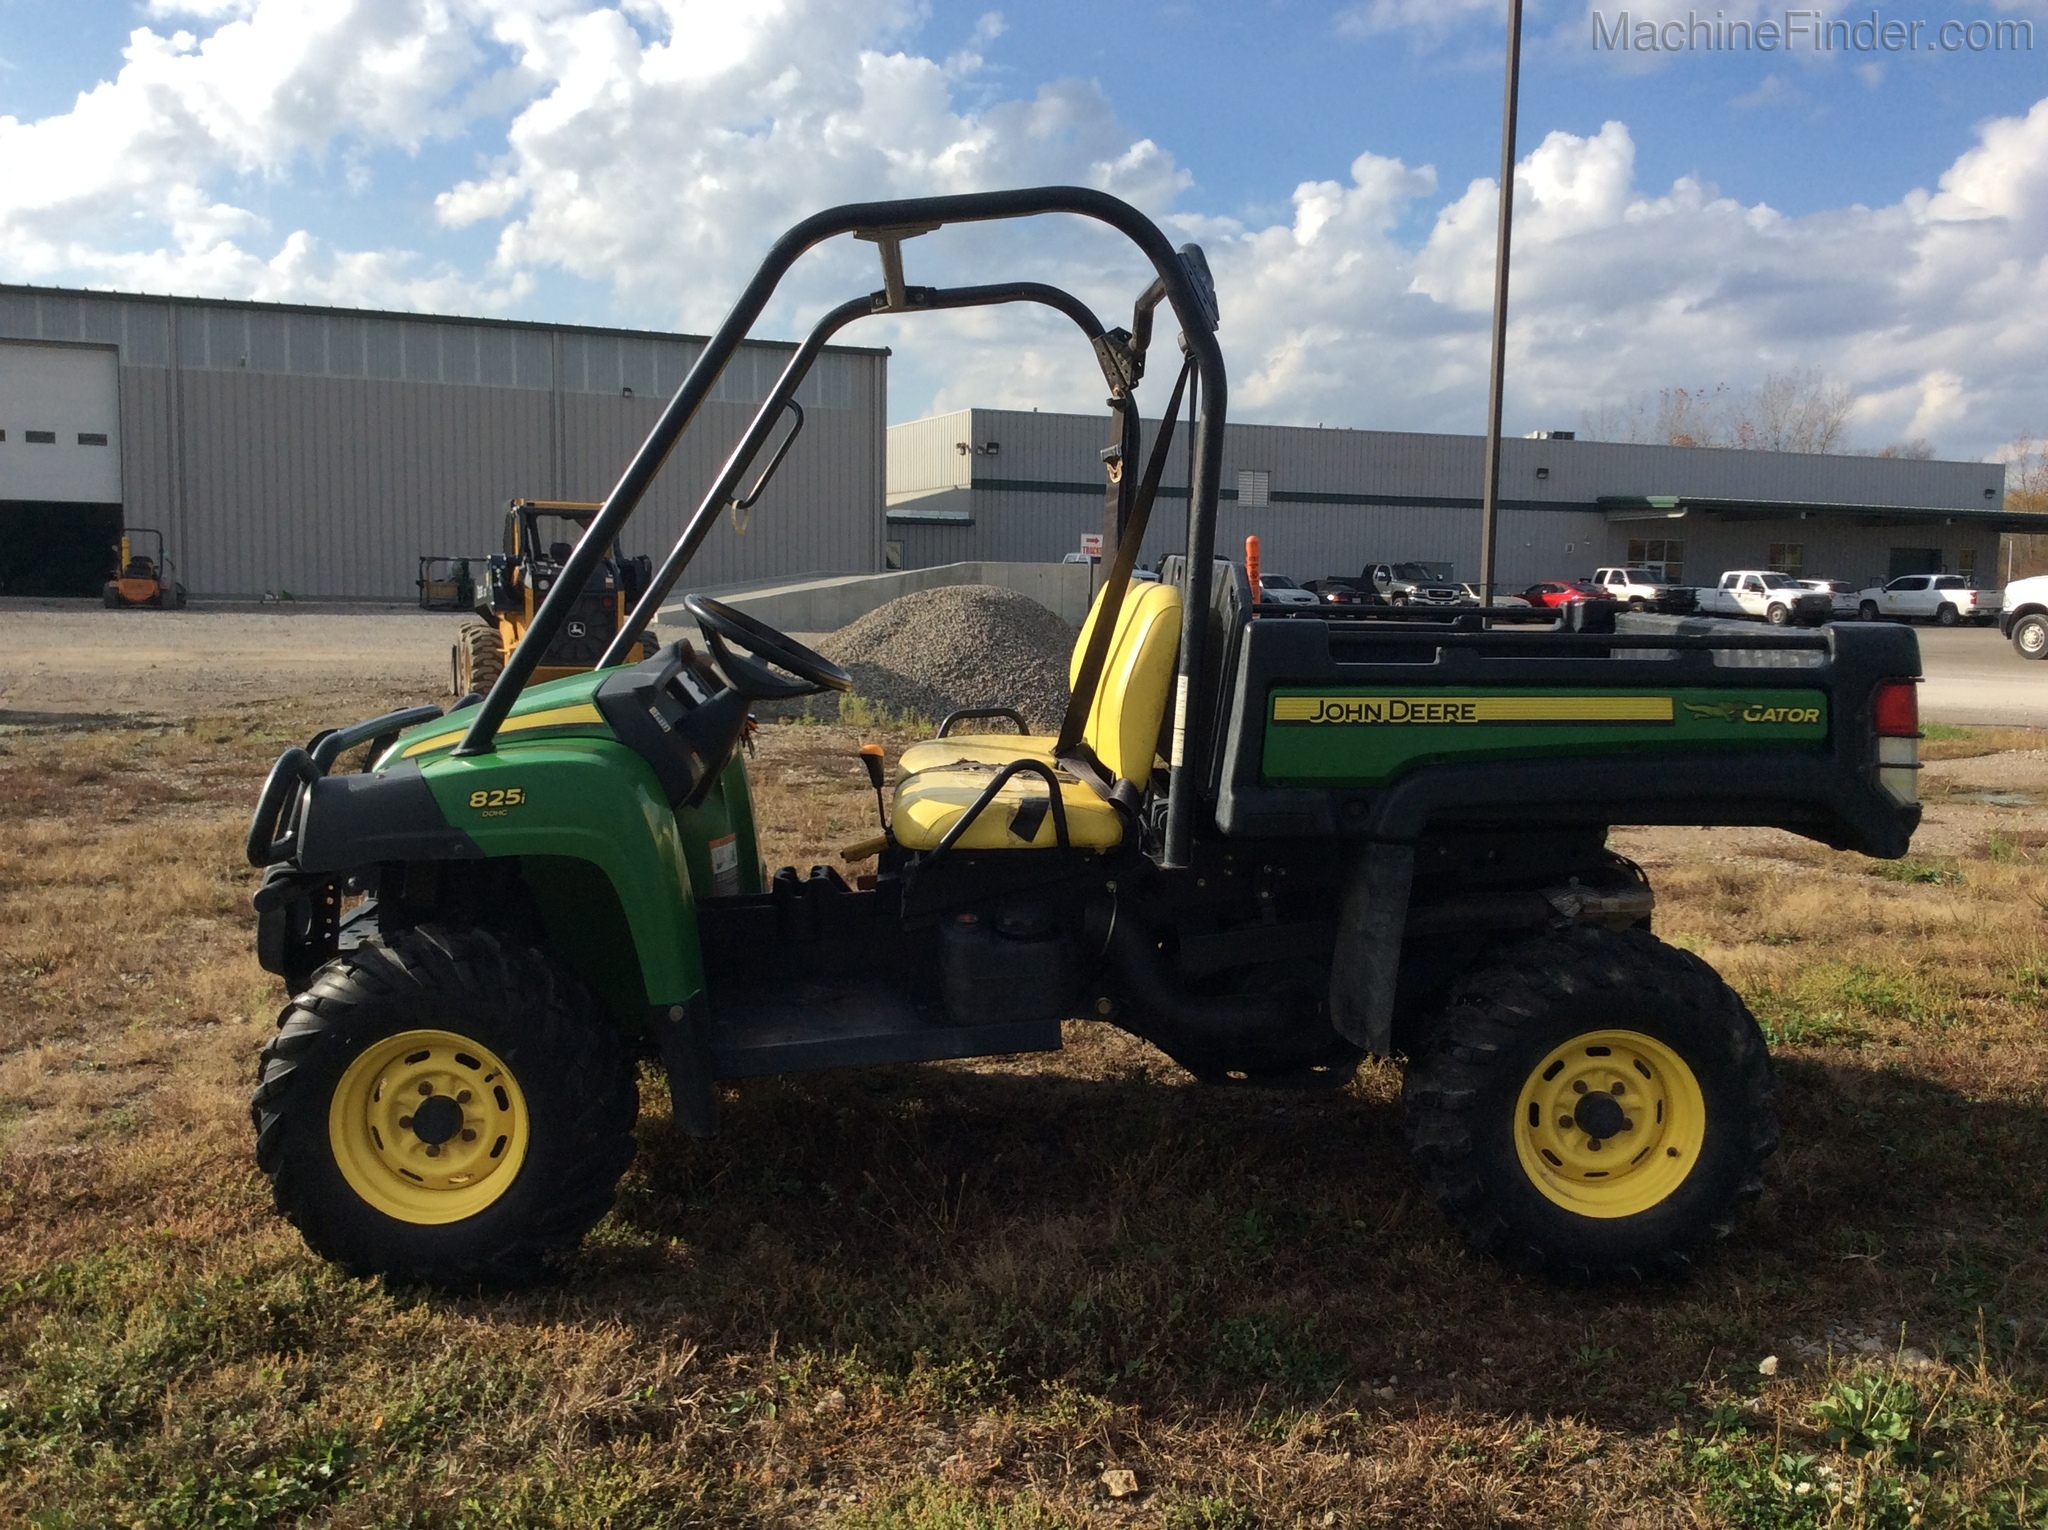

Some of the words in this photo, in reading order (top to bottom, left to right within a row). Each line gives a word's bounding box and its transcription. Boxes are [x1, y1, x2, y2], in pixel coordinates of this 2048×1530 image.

[1310, 700, 1382, 721] JOHN
[1389, 700, 1477, 721] DEERE
[1743, 704, 1820, 723] GATOR
[469, 788, 526, 808] 825i
